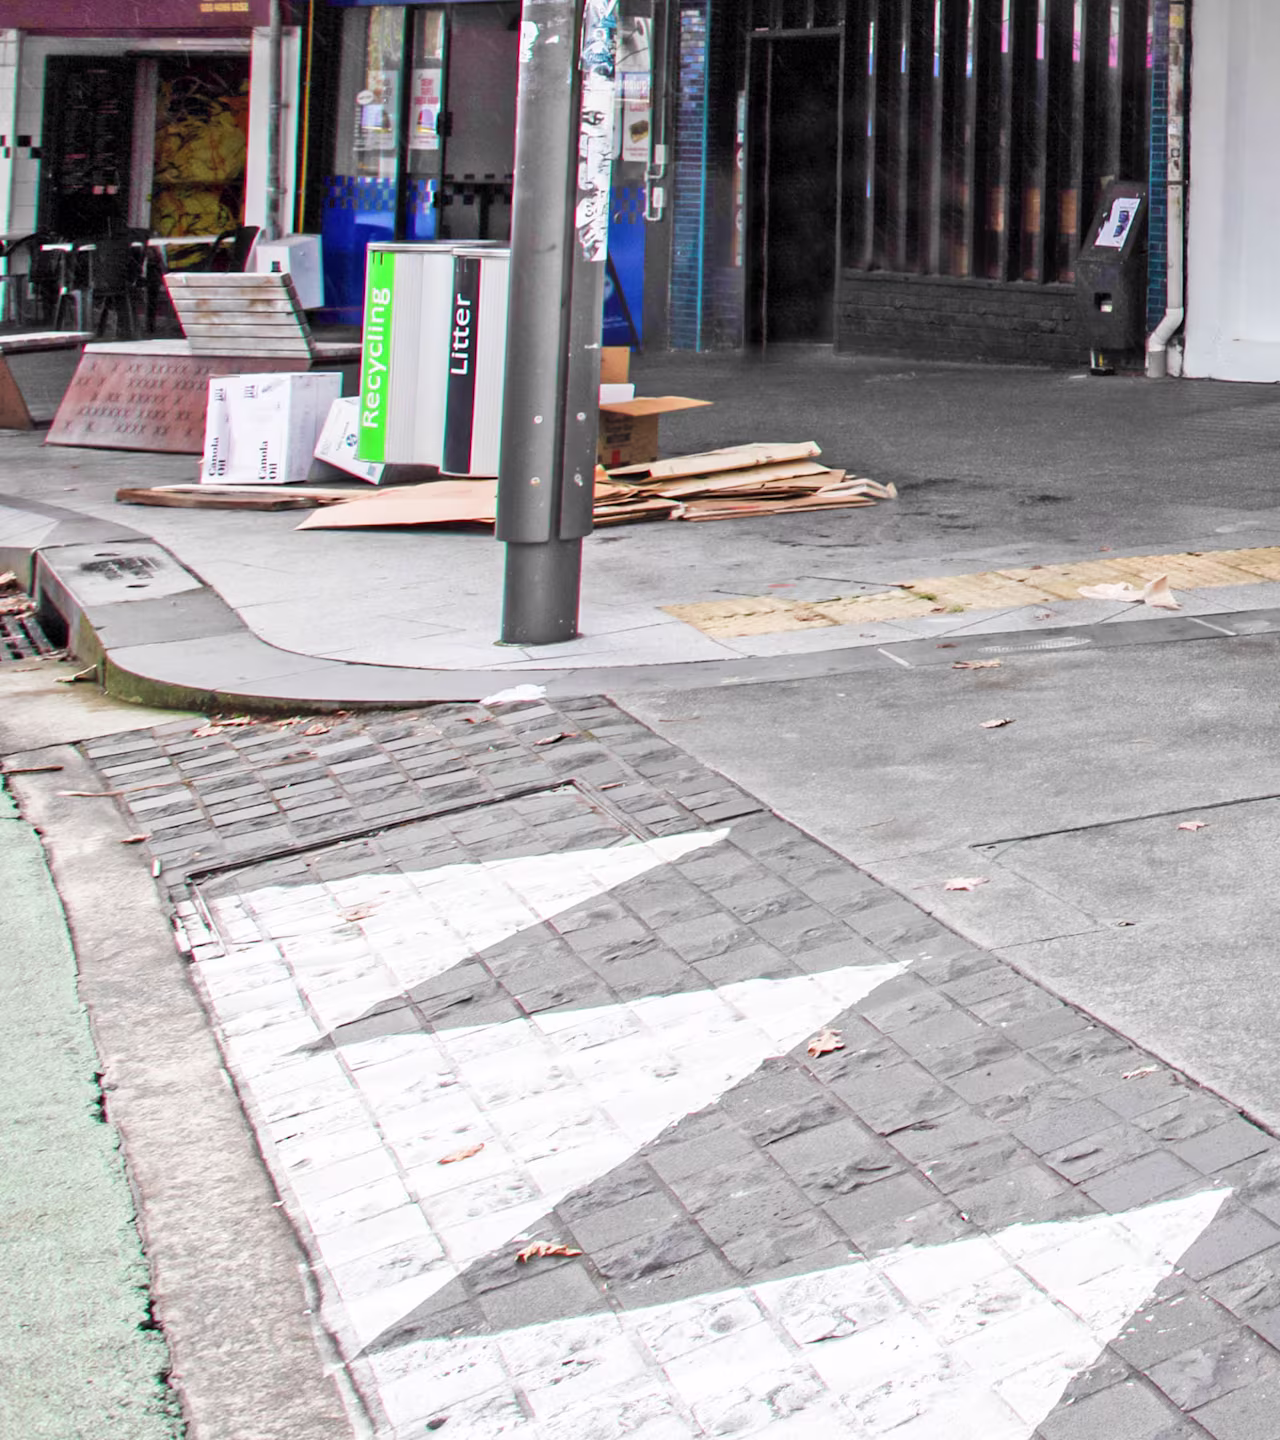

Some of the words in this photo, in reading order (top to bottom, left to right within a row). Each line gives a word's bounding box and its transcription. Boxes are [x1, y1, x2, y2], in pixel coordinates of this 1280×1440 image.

[450, 293, 470, 375] Litter
[362, 287, 390, 428] Recycling
[209, 437, 219, 476] Canola
[218, 459, 226, 476] Oil
[258, 440, 268, 480] Canola
[269, 463, 278, 480] Oil
